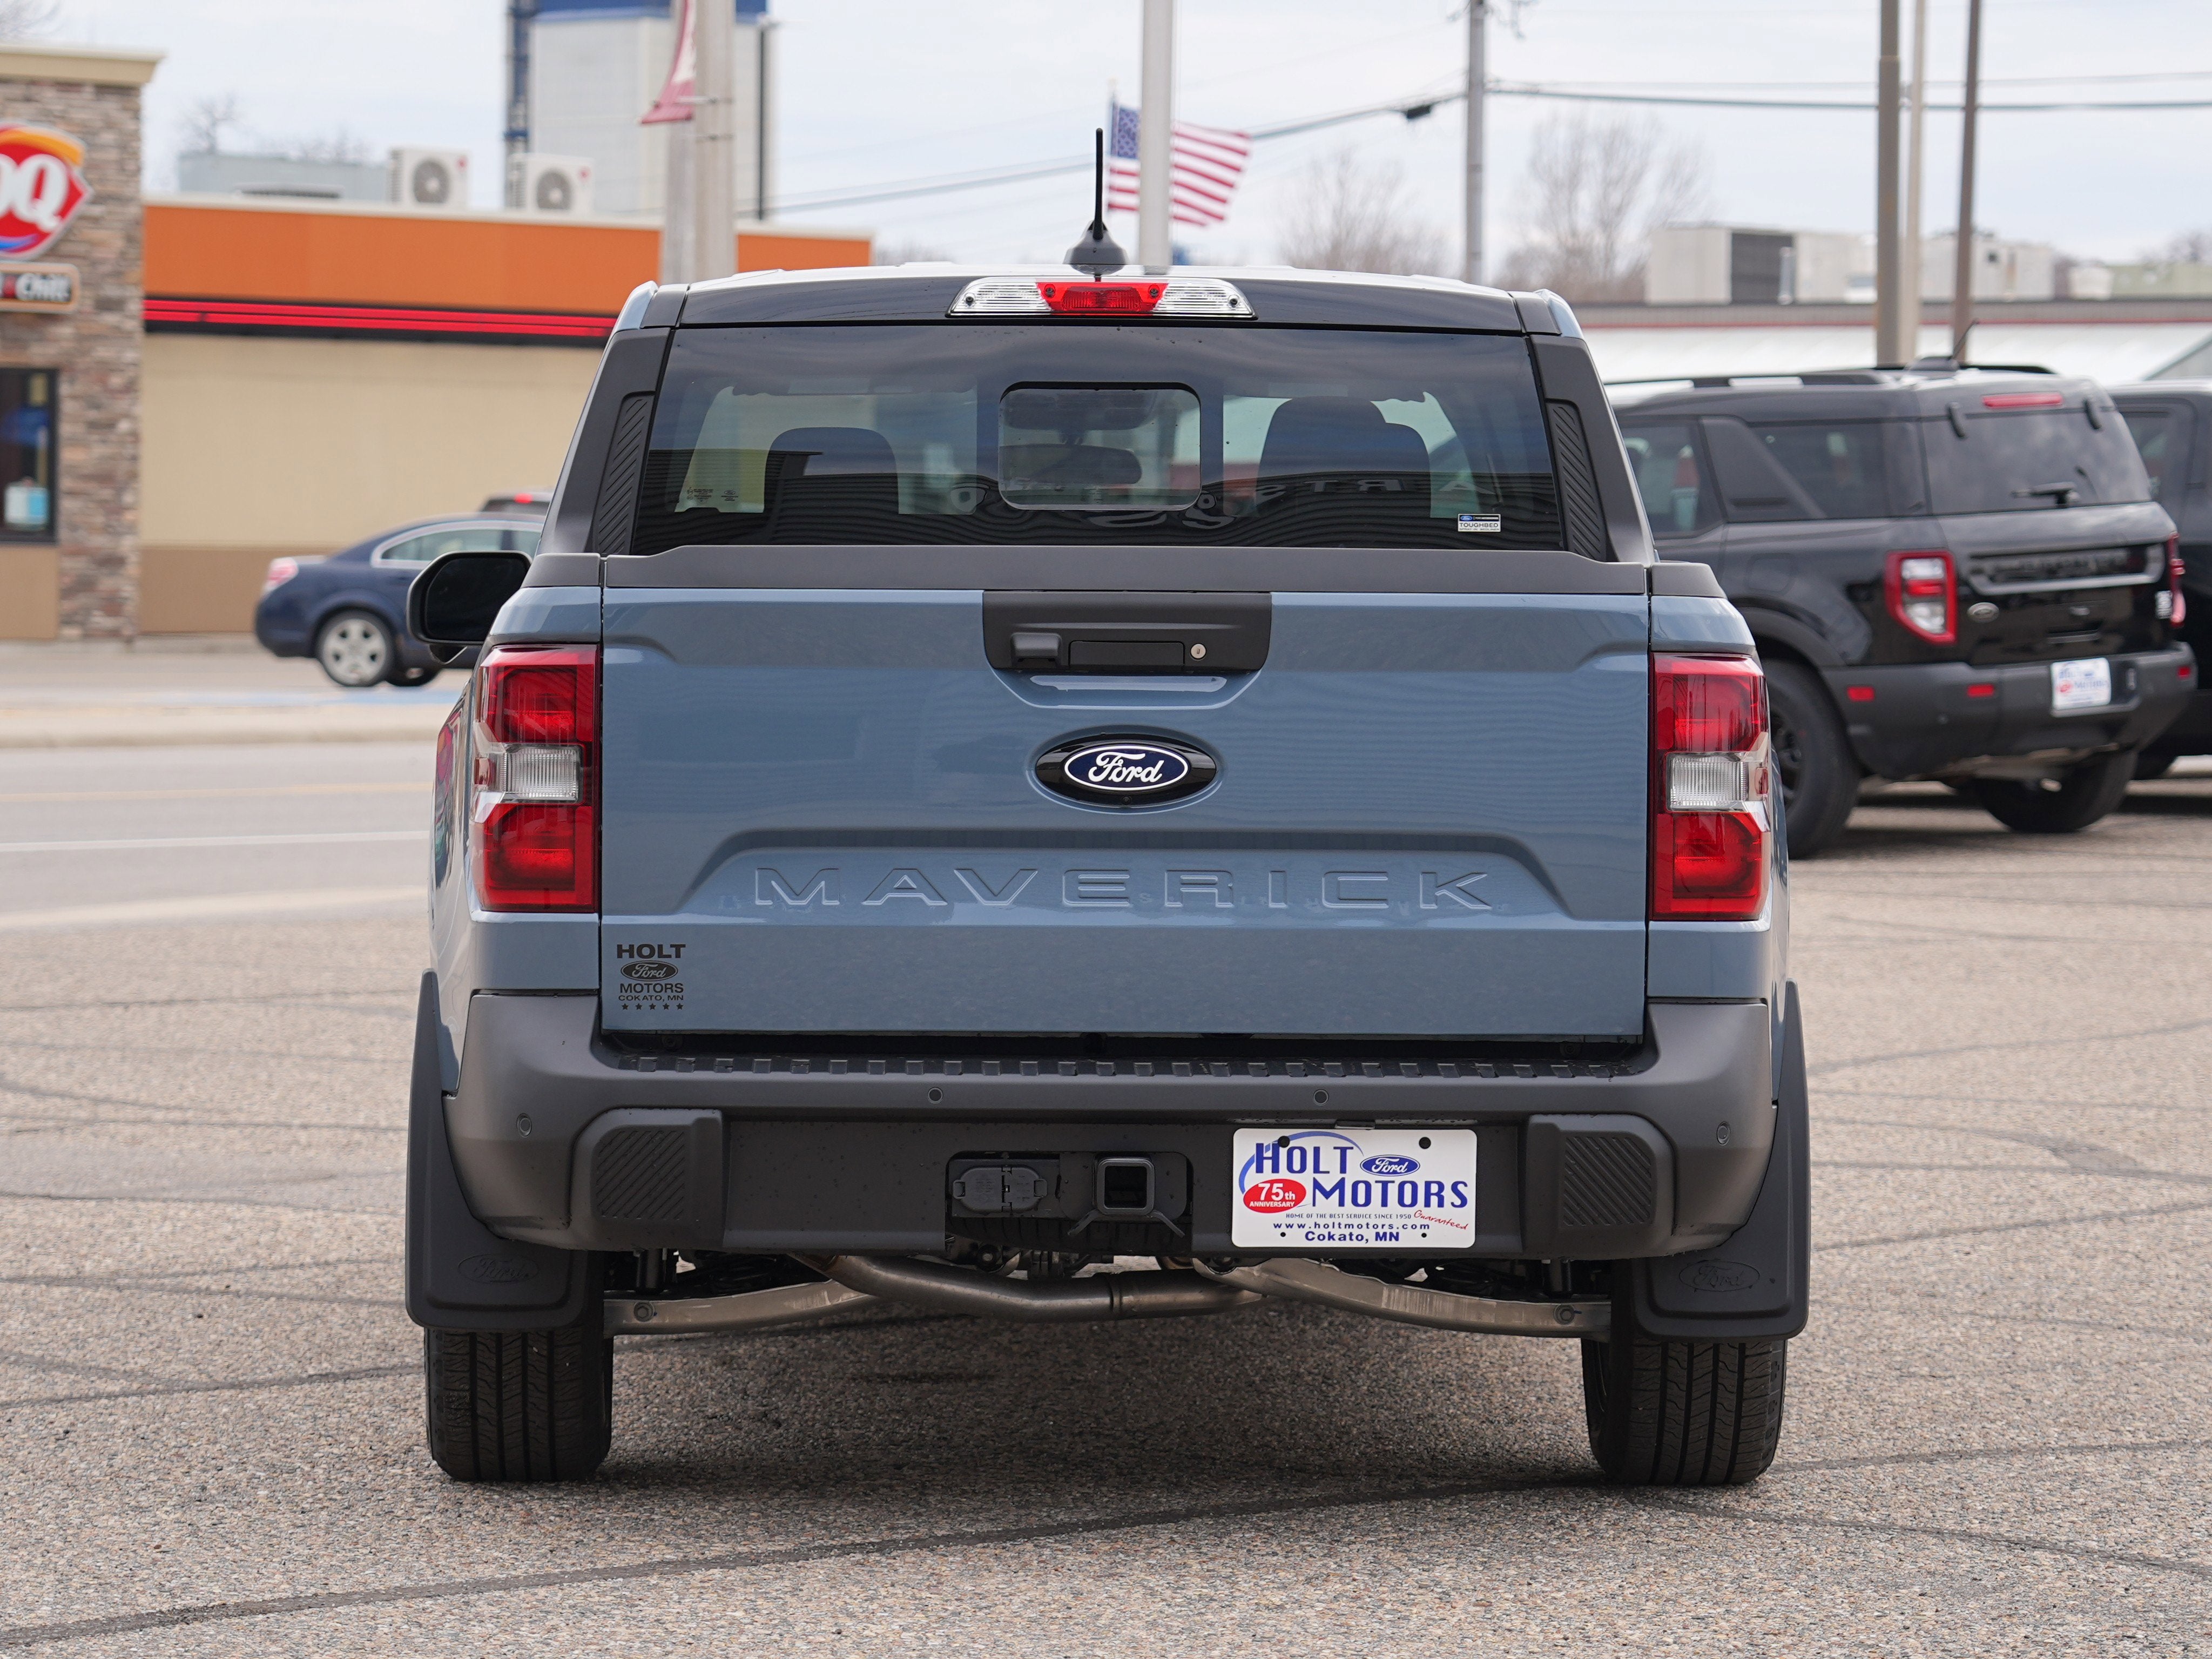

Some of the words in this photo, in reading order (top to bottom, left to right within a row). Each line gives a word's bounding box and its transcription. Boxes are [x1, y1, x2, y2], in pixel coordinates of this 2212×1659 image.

[1088, 751, 1165, 783] Ford
[756, 868, 1493, 910] MAVERICK
[617, 943, 686, 959] HOLT
[632, 963, 667, 978] Ford
[620, 983, 684, 993] MOTORS
[1256, 1143, 1354, 1174] HOLT
[1371, 1157, 1409, 1173] Ford
[1258, 1183, 1296, 1201] 75th
[1312, 1177, 1468, 1208] MOTORS
[1273, 1222, 1430, 1230] www.holtmotors.com
[1414, 1209, 1469, 1230] Guaranteed
[1305, 1231, 1369, 1243] Cokato,
[1375, 1231, 1400, 1242] MN
